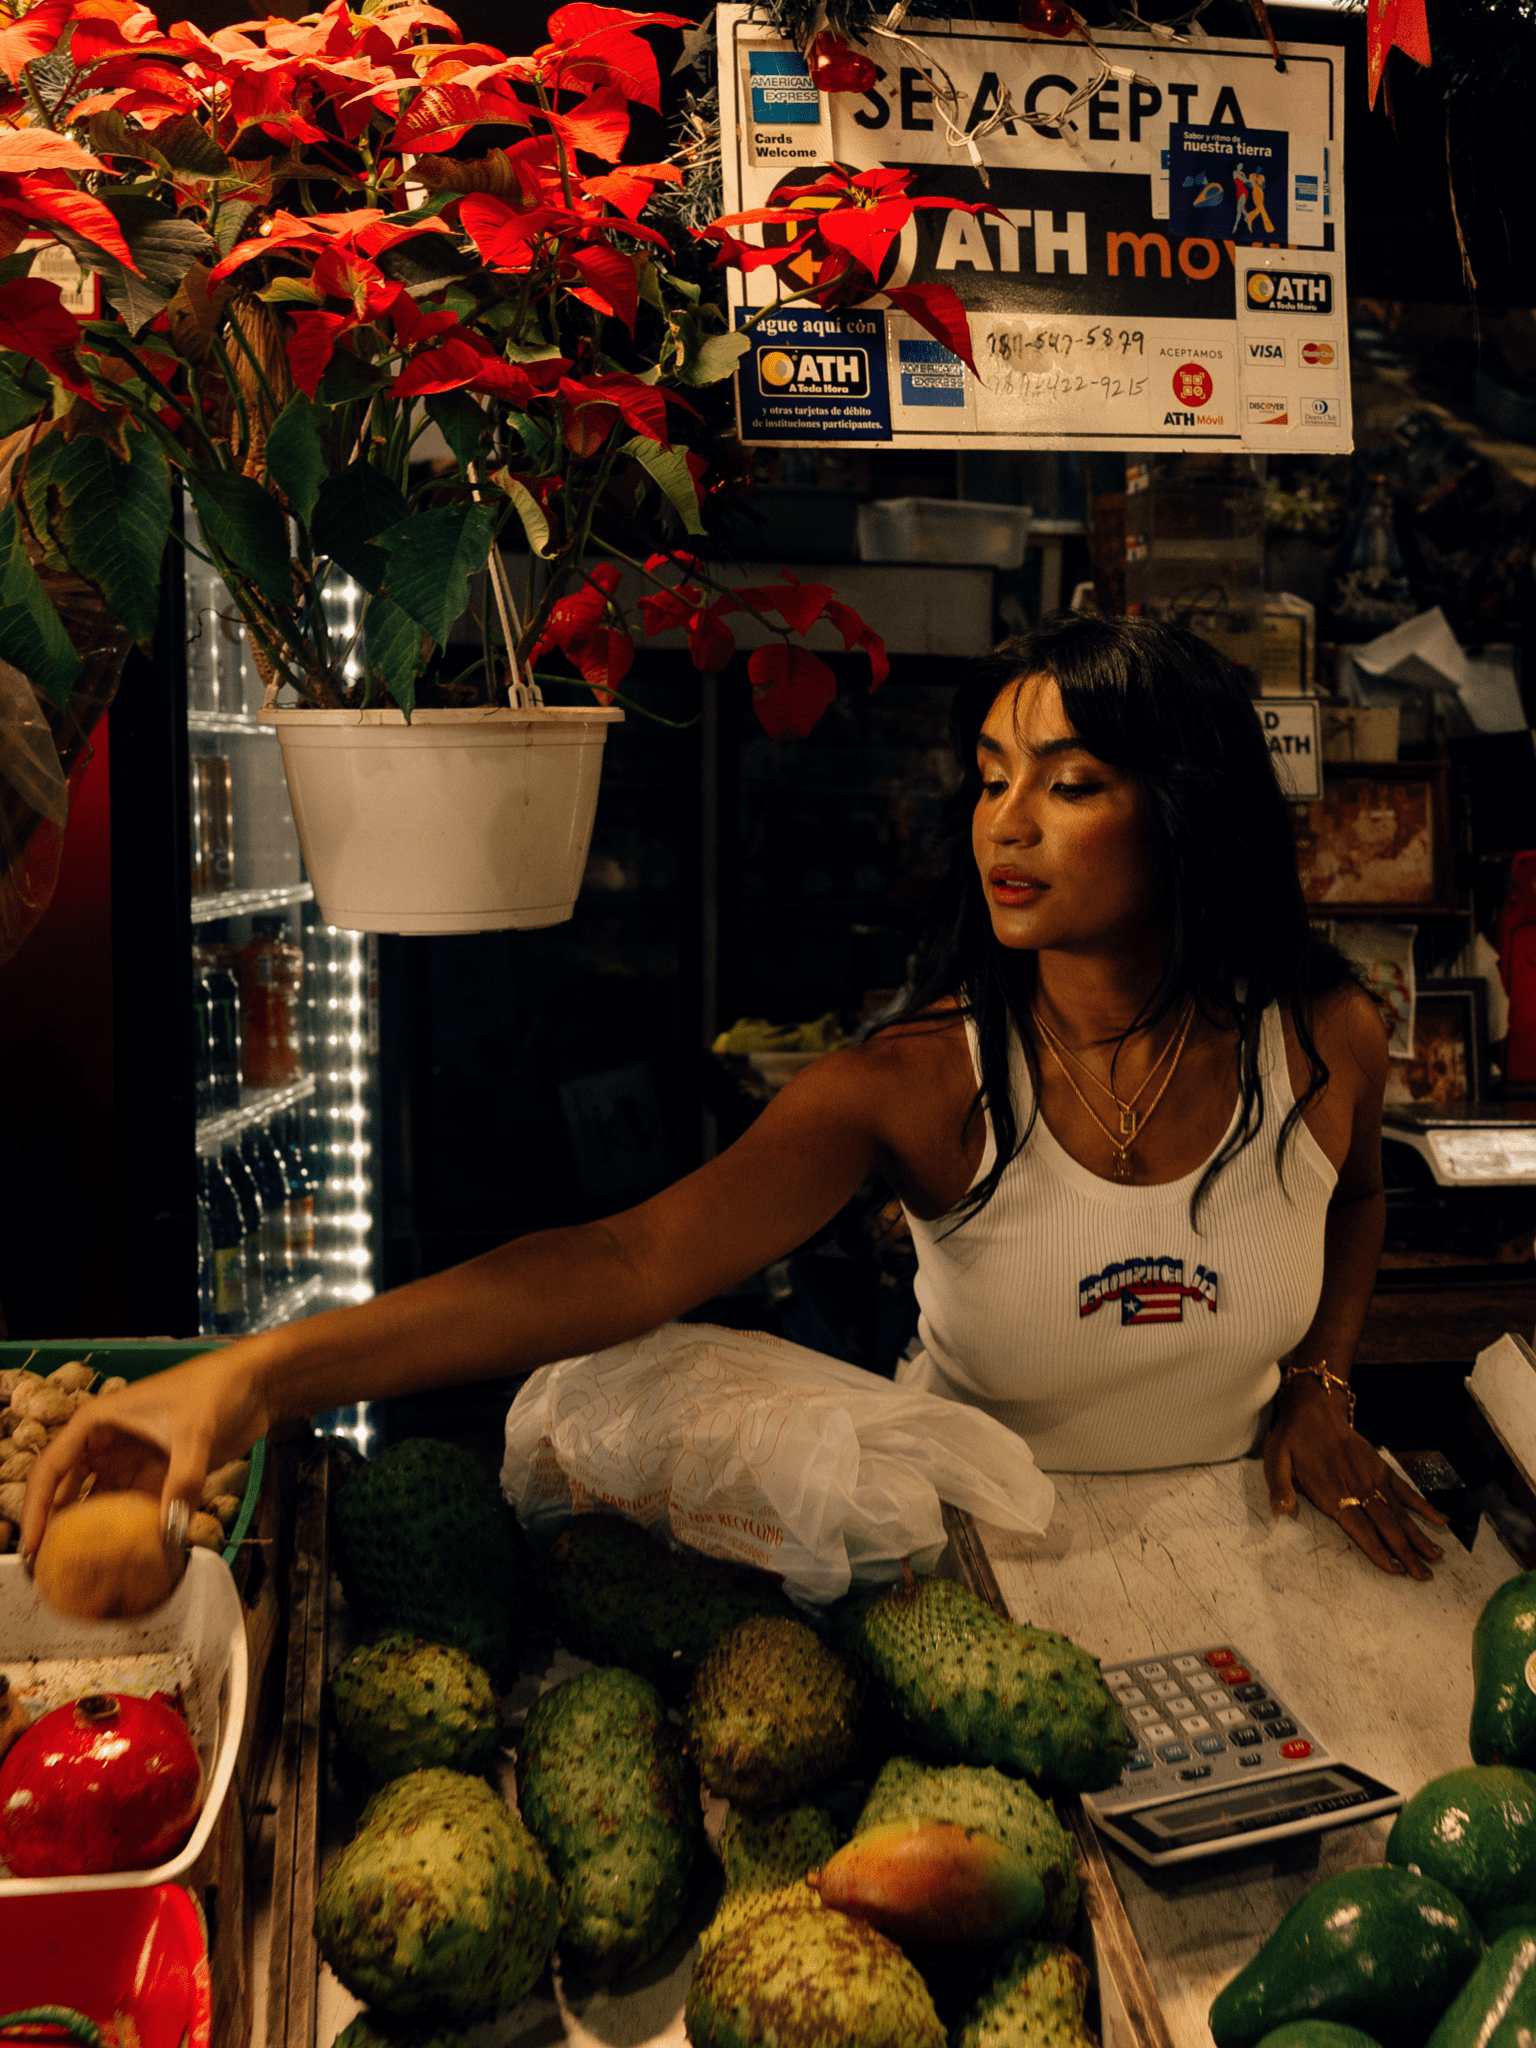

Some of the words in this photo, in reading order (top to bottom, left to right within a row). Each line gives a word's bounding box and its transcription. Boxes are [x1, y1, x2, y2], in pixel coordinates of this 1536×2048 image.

[751, 77, 813, 87] AMERICAN
[765, 91, 818, 101] EXPRESS
[853, 66, 933, 131] SE
[964, 71, 1247, 142] ACEPTA
[755, 134, 793, 144] Cards
[1183, 131, 1204, 140] Sabor
[1211, 134, 1231, 142] ritmo
[1232, 135, 1241, 143] de
[756, 147, 817, 157] Welcome
[1183, 140, 1233, 154] nuestra
[1236, 142, 1272, 157] tierra
[935, 208, 1087, 274] ATH
[1276, 277, 1325, 302] ATH
[1276, 301, 1296, 310] Toda
[1297, 302, 1317, 311] Hora
[802, 317, 842, 337] aquí
[1159, 347, 1223, 359] ACEPTAMOS
[1249, 344, 1283, 359] VISA
[797, 354, 859, 382] ATH
[901, 363, 961, 373] AMERICAN
[914, 377, 964, 386] EXPRESS
[788, 383, 797, 393] A
[797, 383, 822, 393] Toda
[823, 384, 849, 393] Hora
[769, 406, 793, 415] otras
[794, 405, 829, 417] tarjetas
[830, 406, 842, 415] de
[843, 406, 872, 416] débito
[1249, 402, 1285, 411] DISCOVER
[752, 419, 763, 427] de
[765, 419, 821, 428] instituciones
[822, 419, 883, 431] participantes.
[1163, 412, 1195, 426] ATH
[1196, 415, 1224, 426] Móvil
[1269, 735, 1310, 754] ATH
[718, 1513, 783, 1548] RECYCLING
